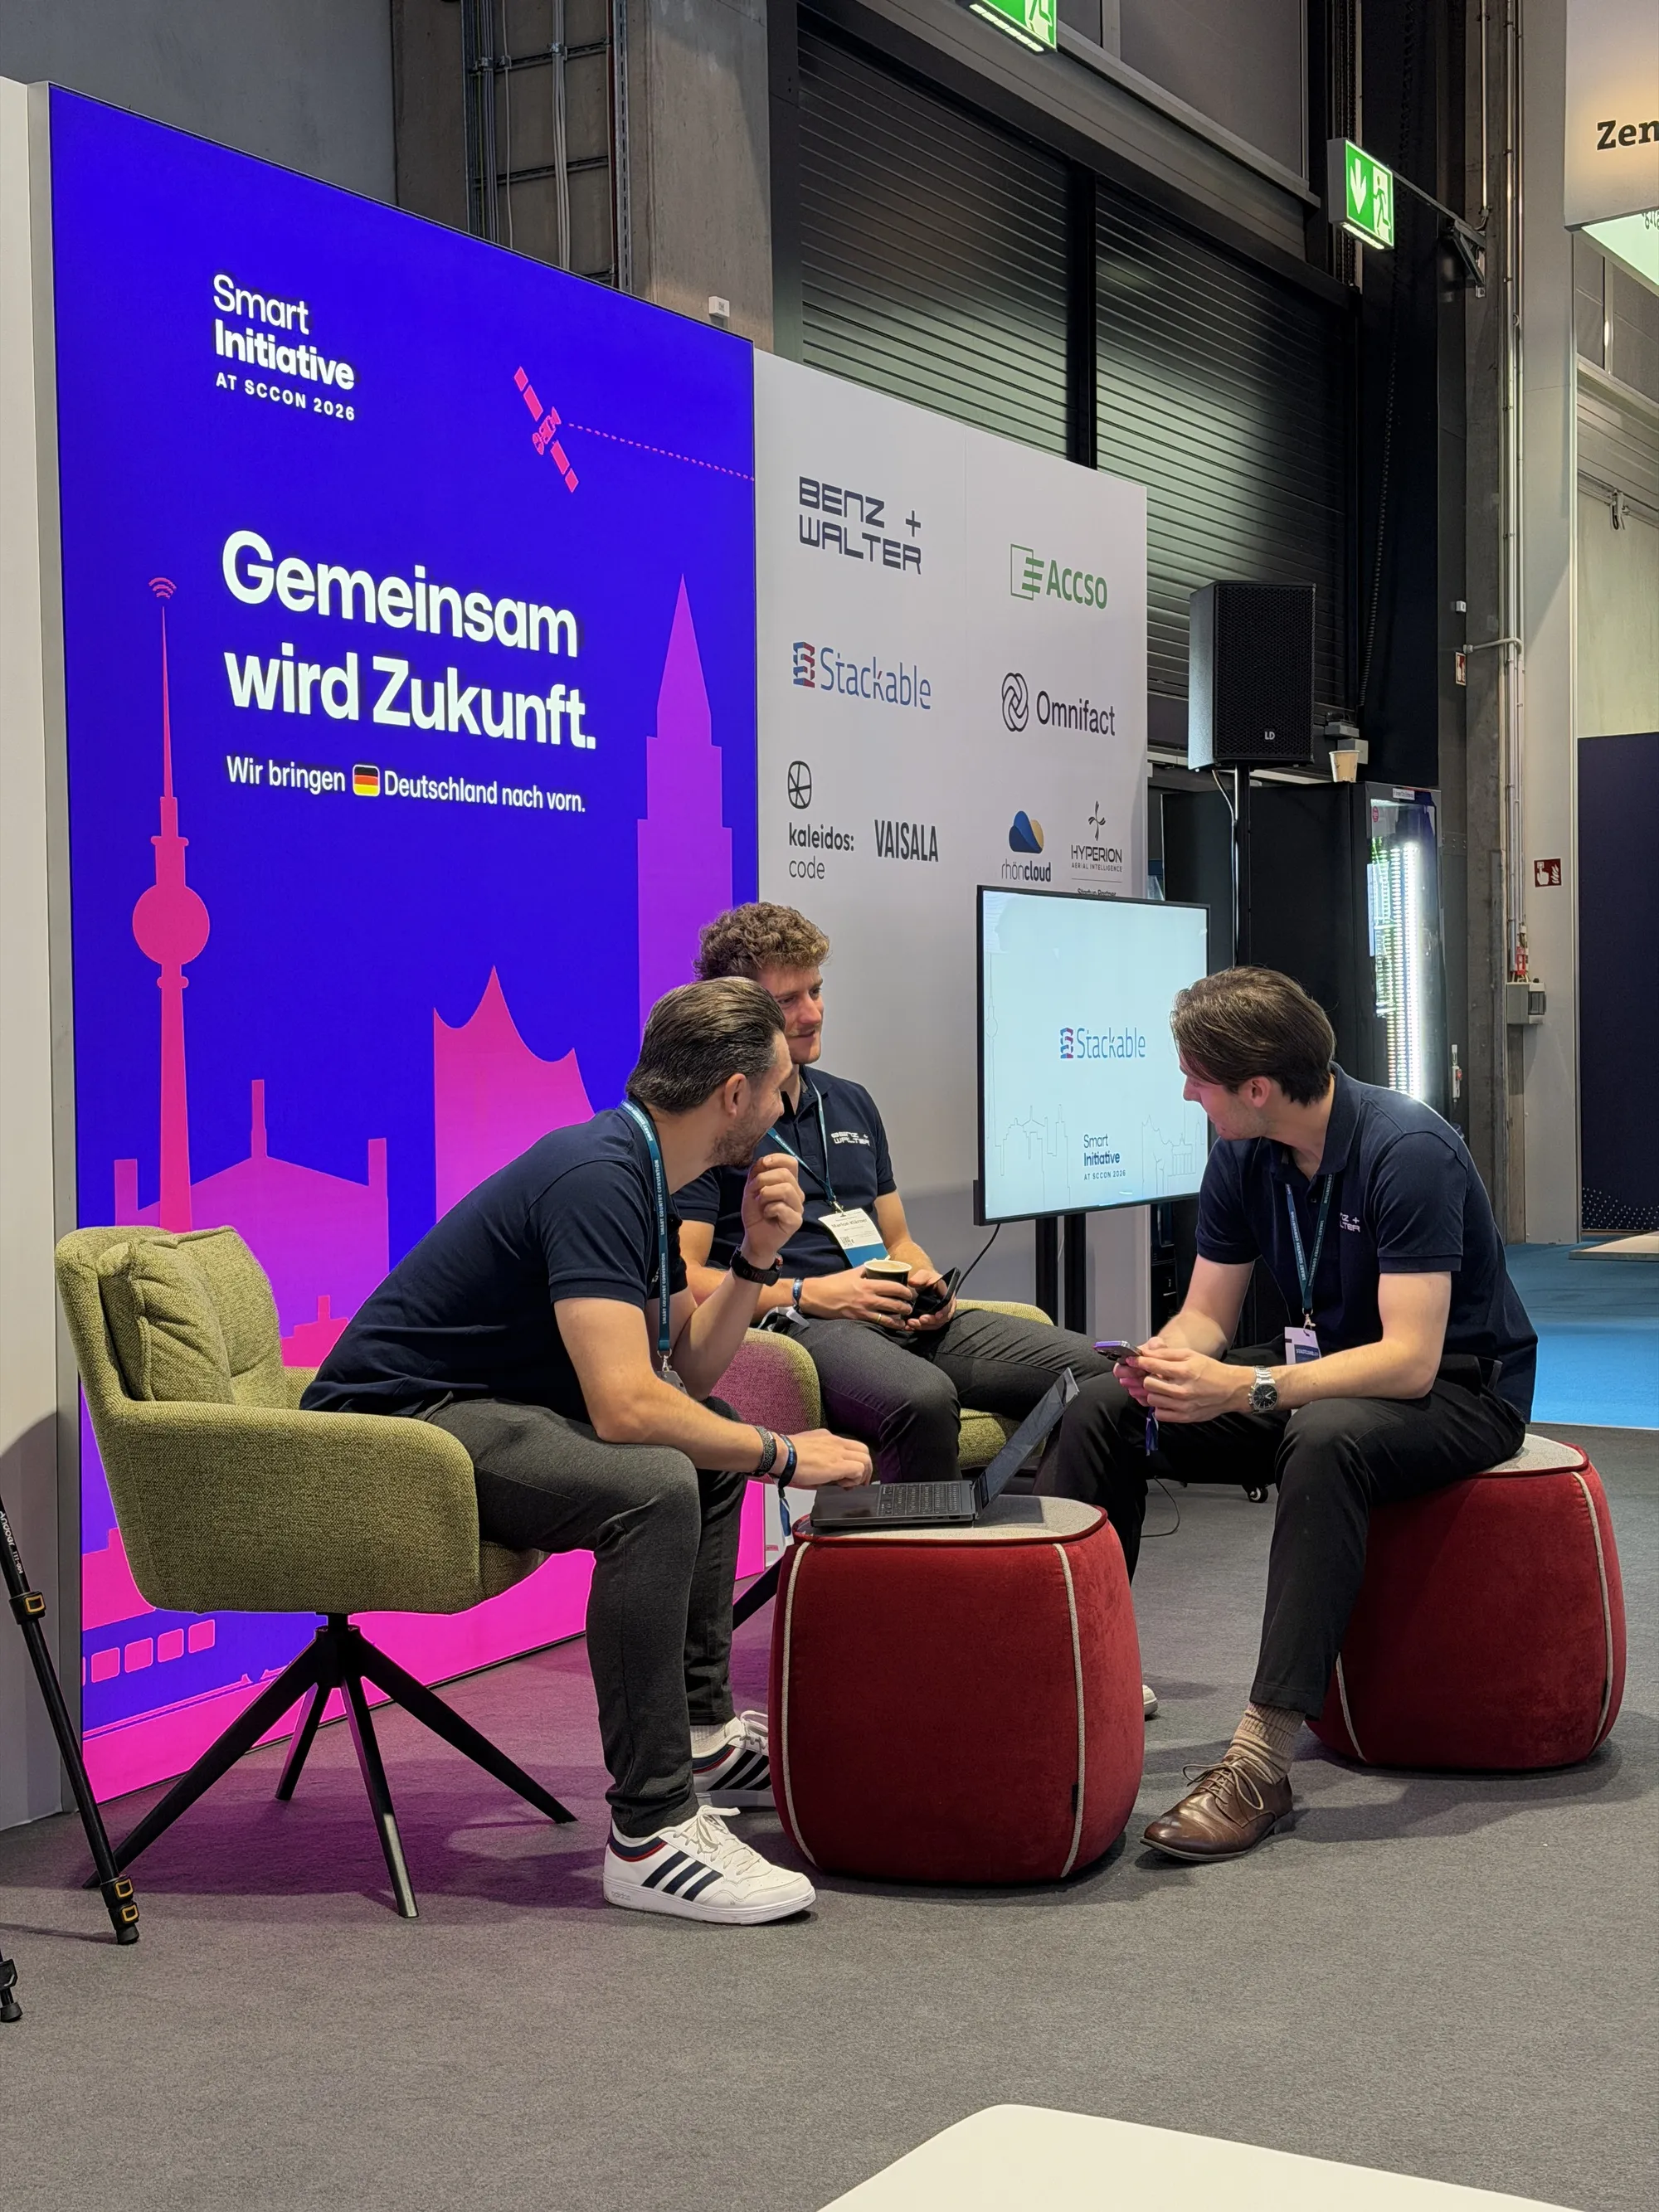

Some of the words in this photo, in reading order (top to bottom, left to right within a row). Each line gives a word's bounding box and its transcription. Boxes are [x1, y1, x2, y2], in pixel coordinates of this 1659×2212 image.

[213, 274, 309, 335] Smart
[215, 318, 355, 391] Initiative
[216, 372, 237, 391] AT
[244, 379, 306, 409] SCCON
[313, 397, 355, 421] 2026
[799, 475, 885, 529] BENZ
[905, 509, 922, 537] +
[799, 513, 922, 576] WALTER
[221, 530, 578, 658] Gemeinsam
[223, 642, 359, 721] wird
[372, 655, 596, 750] Zukunft.
[820, 646, 932, 711] Stackable
[1036, 689, 1116, 737] Omnifact
[1264, 731, 1276, 740] LD
[226, 755, 264, 785] Wir
[268, 759, 346, 795] bringen
[384, 770, 498, 805] Deutschland
[502, 785, 543, 809] nach
[546, 791, 586, 813] vorn.
[789, 822, 854, 852] kaleidos:
[874, 819, 940, 863] VAISALA
[1071, 844, 1122, 863] HYPERION
[789, 855, 825, 880] code
[1001, 858, 1052, 882] rhöncloud
[1071, 862, 1089, 870] AERIAL
[1089, 863, 1123, 873] INTELLIGENCE
[1077, 1027, 1146, 1059] Stackable
[1083, 1134, 1109, 1150] Smart
[1083, 1150, 1121, 1167] Initiative
[654, 1159, 662, 1194] CONVENTION
[1083, 1173, 1091, 1181] AT
[1092, 1170, 1112, 1180] SCCON
[1112, 1169, 1126, 1178] 2026
